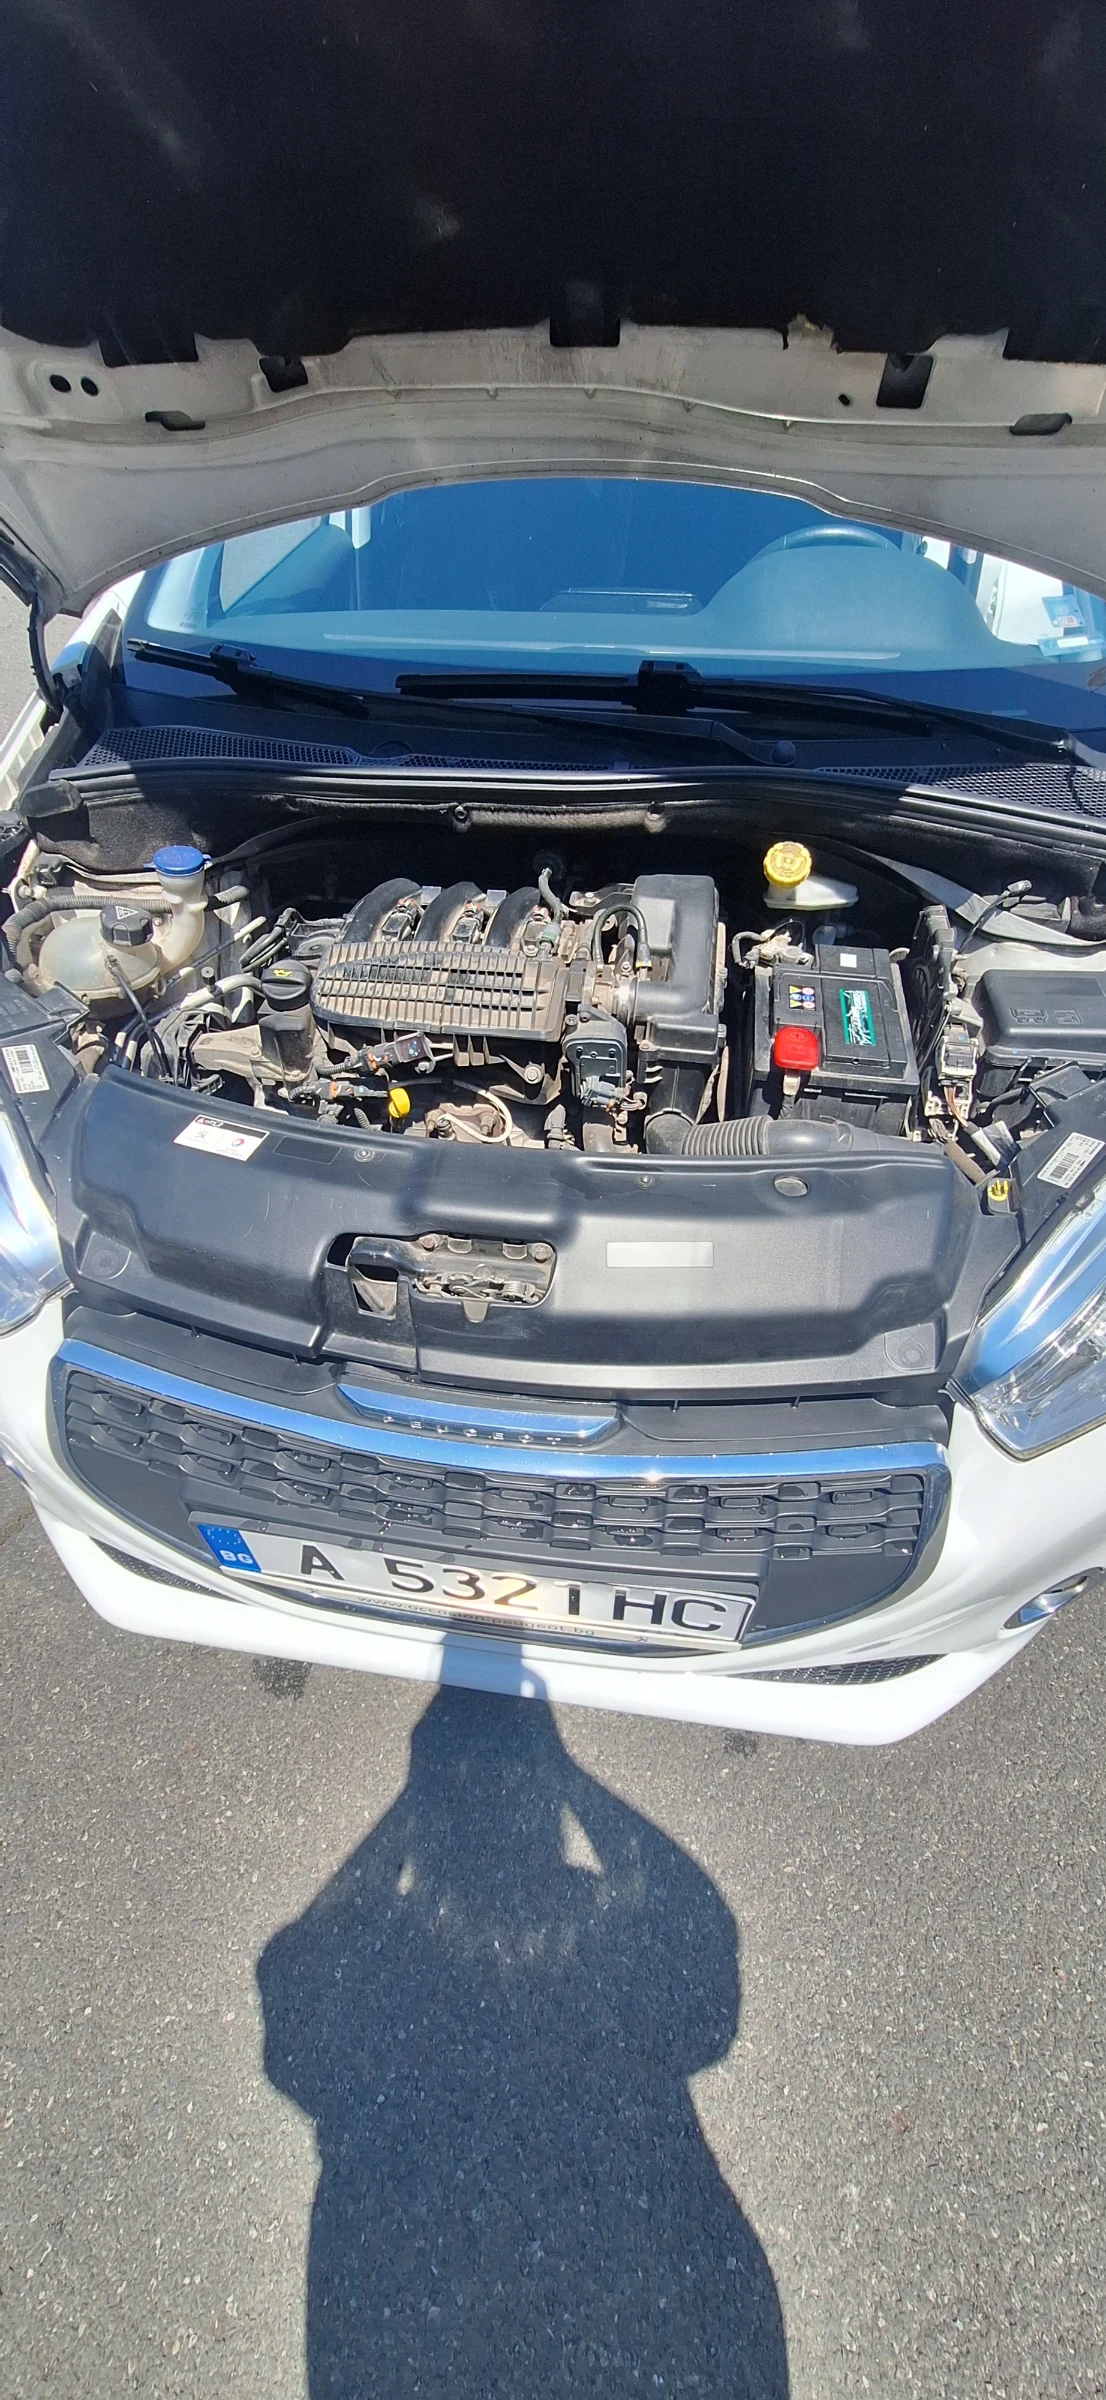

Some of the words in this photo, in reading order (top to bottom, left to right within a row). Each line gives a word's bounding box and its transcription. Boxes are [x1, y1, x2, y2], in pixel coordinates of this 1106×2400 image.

[382, 1415, 562, 1445] PEUGEOT
[218, 1549, 255, 1565] BG
[300, 1544, 346, 1581] A
[382, 1556, 582, 1616] 5321
[612, 1587, 727, 1632] HC
